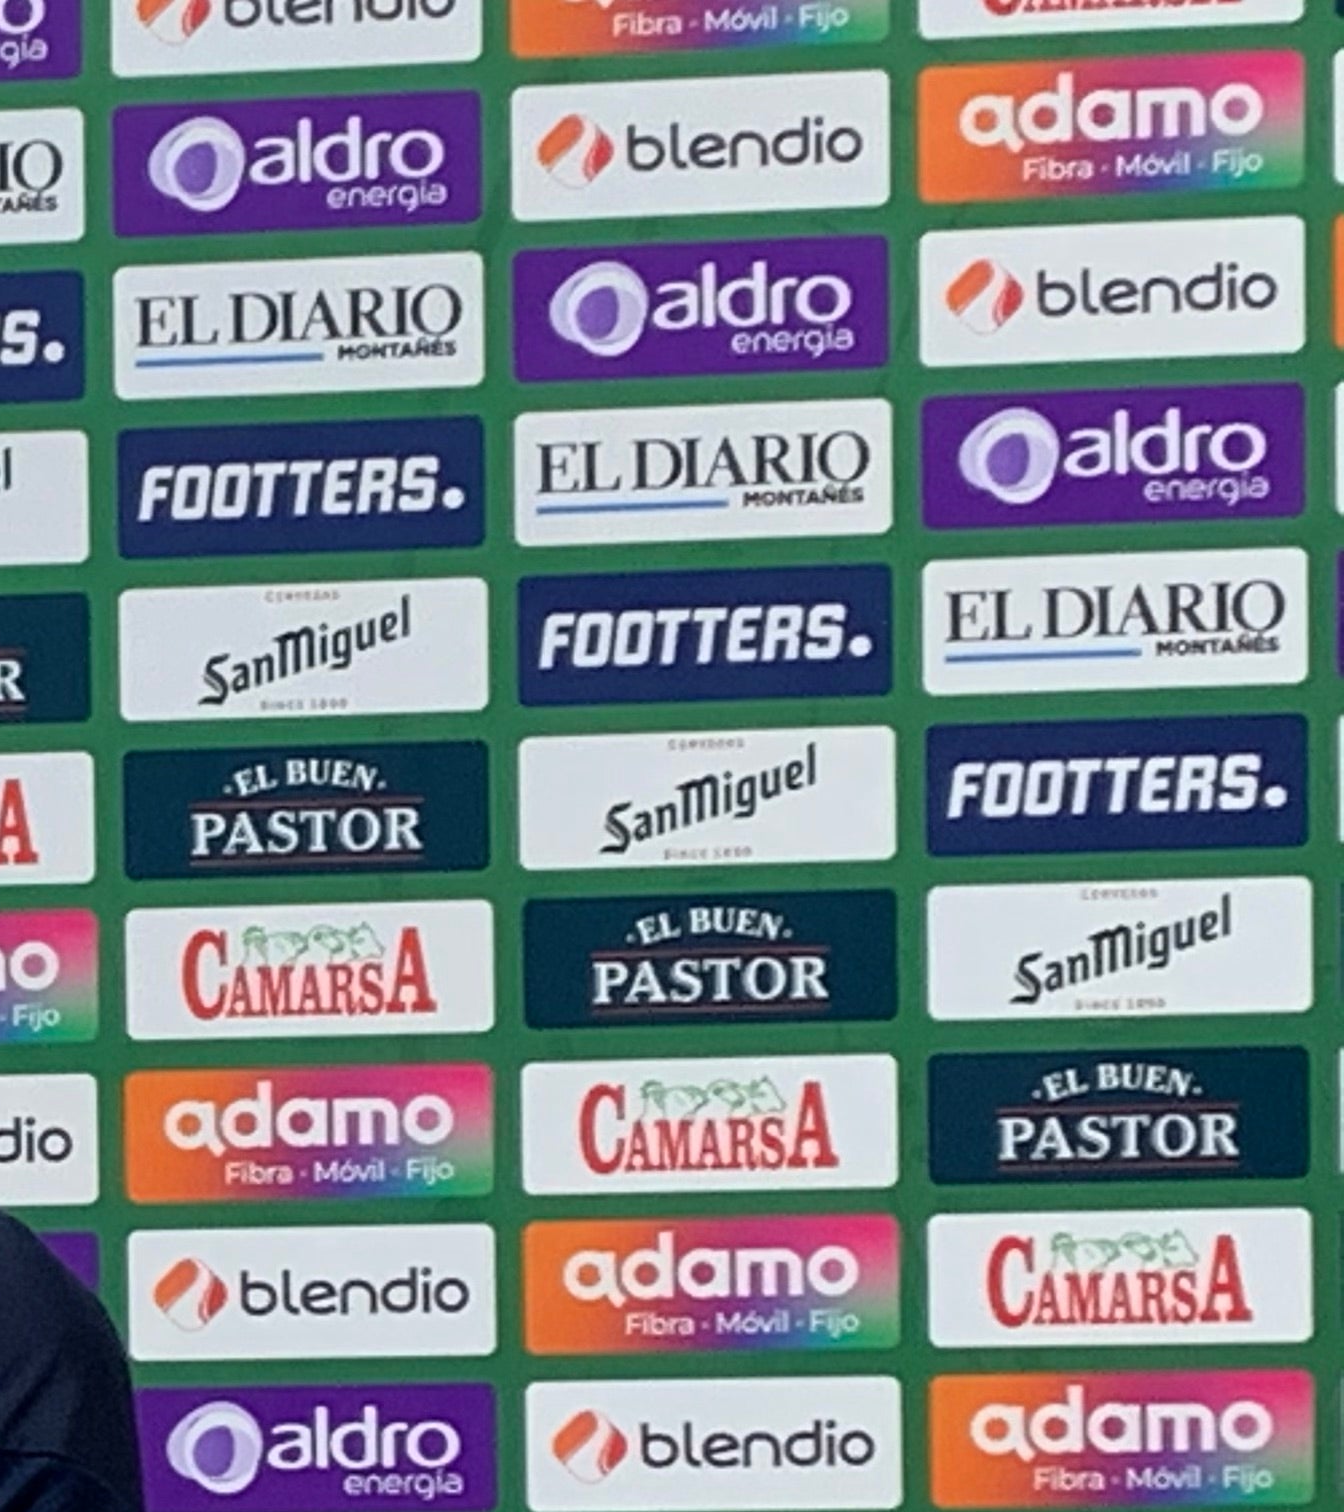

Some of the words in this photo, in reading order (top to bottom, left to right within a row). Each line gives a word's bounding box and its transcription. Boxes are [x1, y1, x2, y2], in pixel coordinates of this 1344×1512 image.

[612, 12, 683, 37] Fibra
[703, 6, 779, 32] Móvil
[799, 4, 851, 33] Fijo
[249, 115, 444, 185] aldro
[626, 115, 863, 172] blendio
[137, 295, 219, 348] EL
[229, 283, 463, 344] DIARIO
[651, 260, 852, 330] aldro
[1036, 261, 1278, 318] blendio
[945, 589, 1033, 643] EL
[1042, 579, 1286, 639] DIARIO
[12, 1004, 62, 1033] Fijo
[1042, 1068, 1090, 1101] EL
[1096, 1063, 1197, 1097] BUEN
[163, 1079, 454, 1155] adamo
[997, 1113, 1240, 1161] PASTOR
[224, 1161, 295, 1185] Fibra
[312, 1157, 386, 1183] Móvil
[406, 1158, 455, 1186] Fijo
[270, 1405, 461, 1470] aldro
[969, 1384, 1272, 1462] adamo
[1032, 1465, 1107, 1491] Fibra
[1125, 1464, 1202, 1491] Móvil
[1222, 1465, 1273, 1494] Fijo
